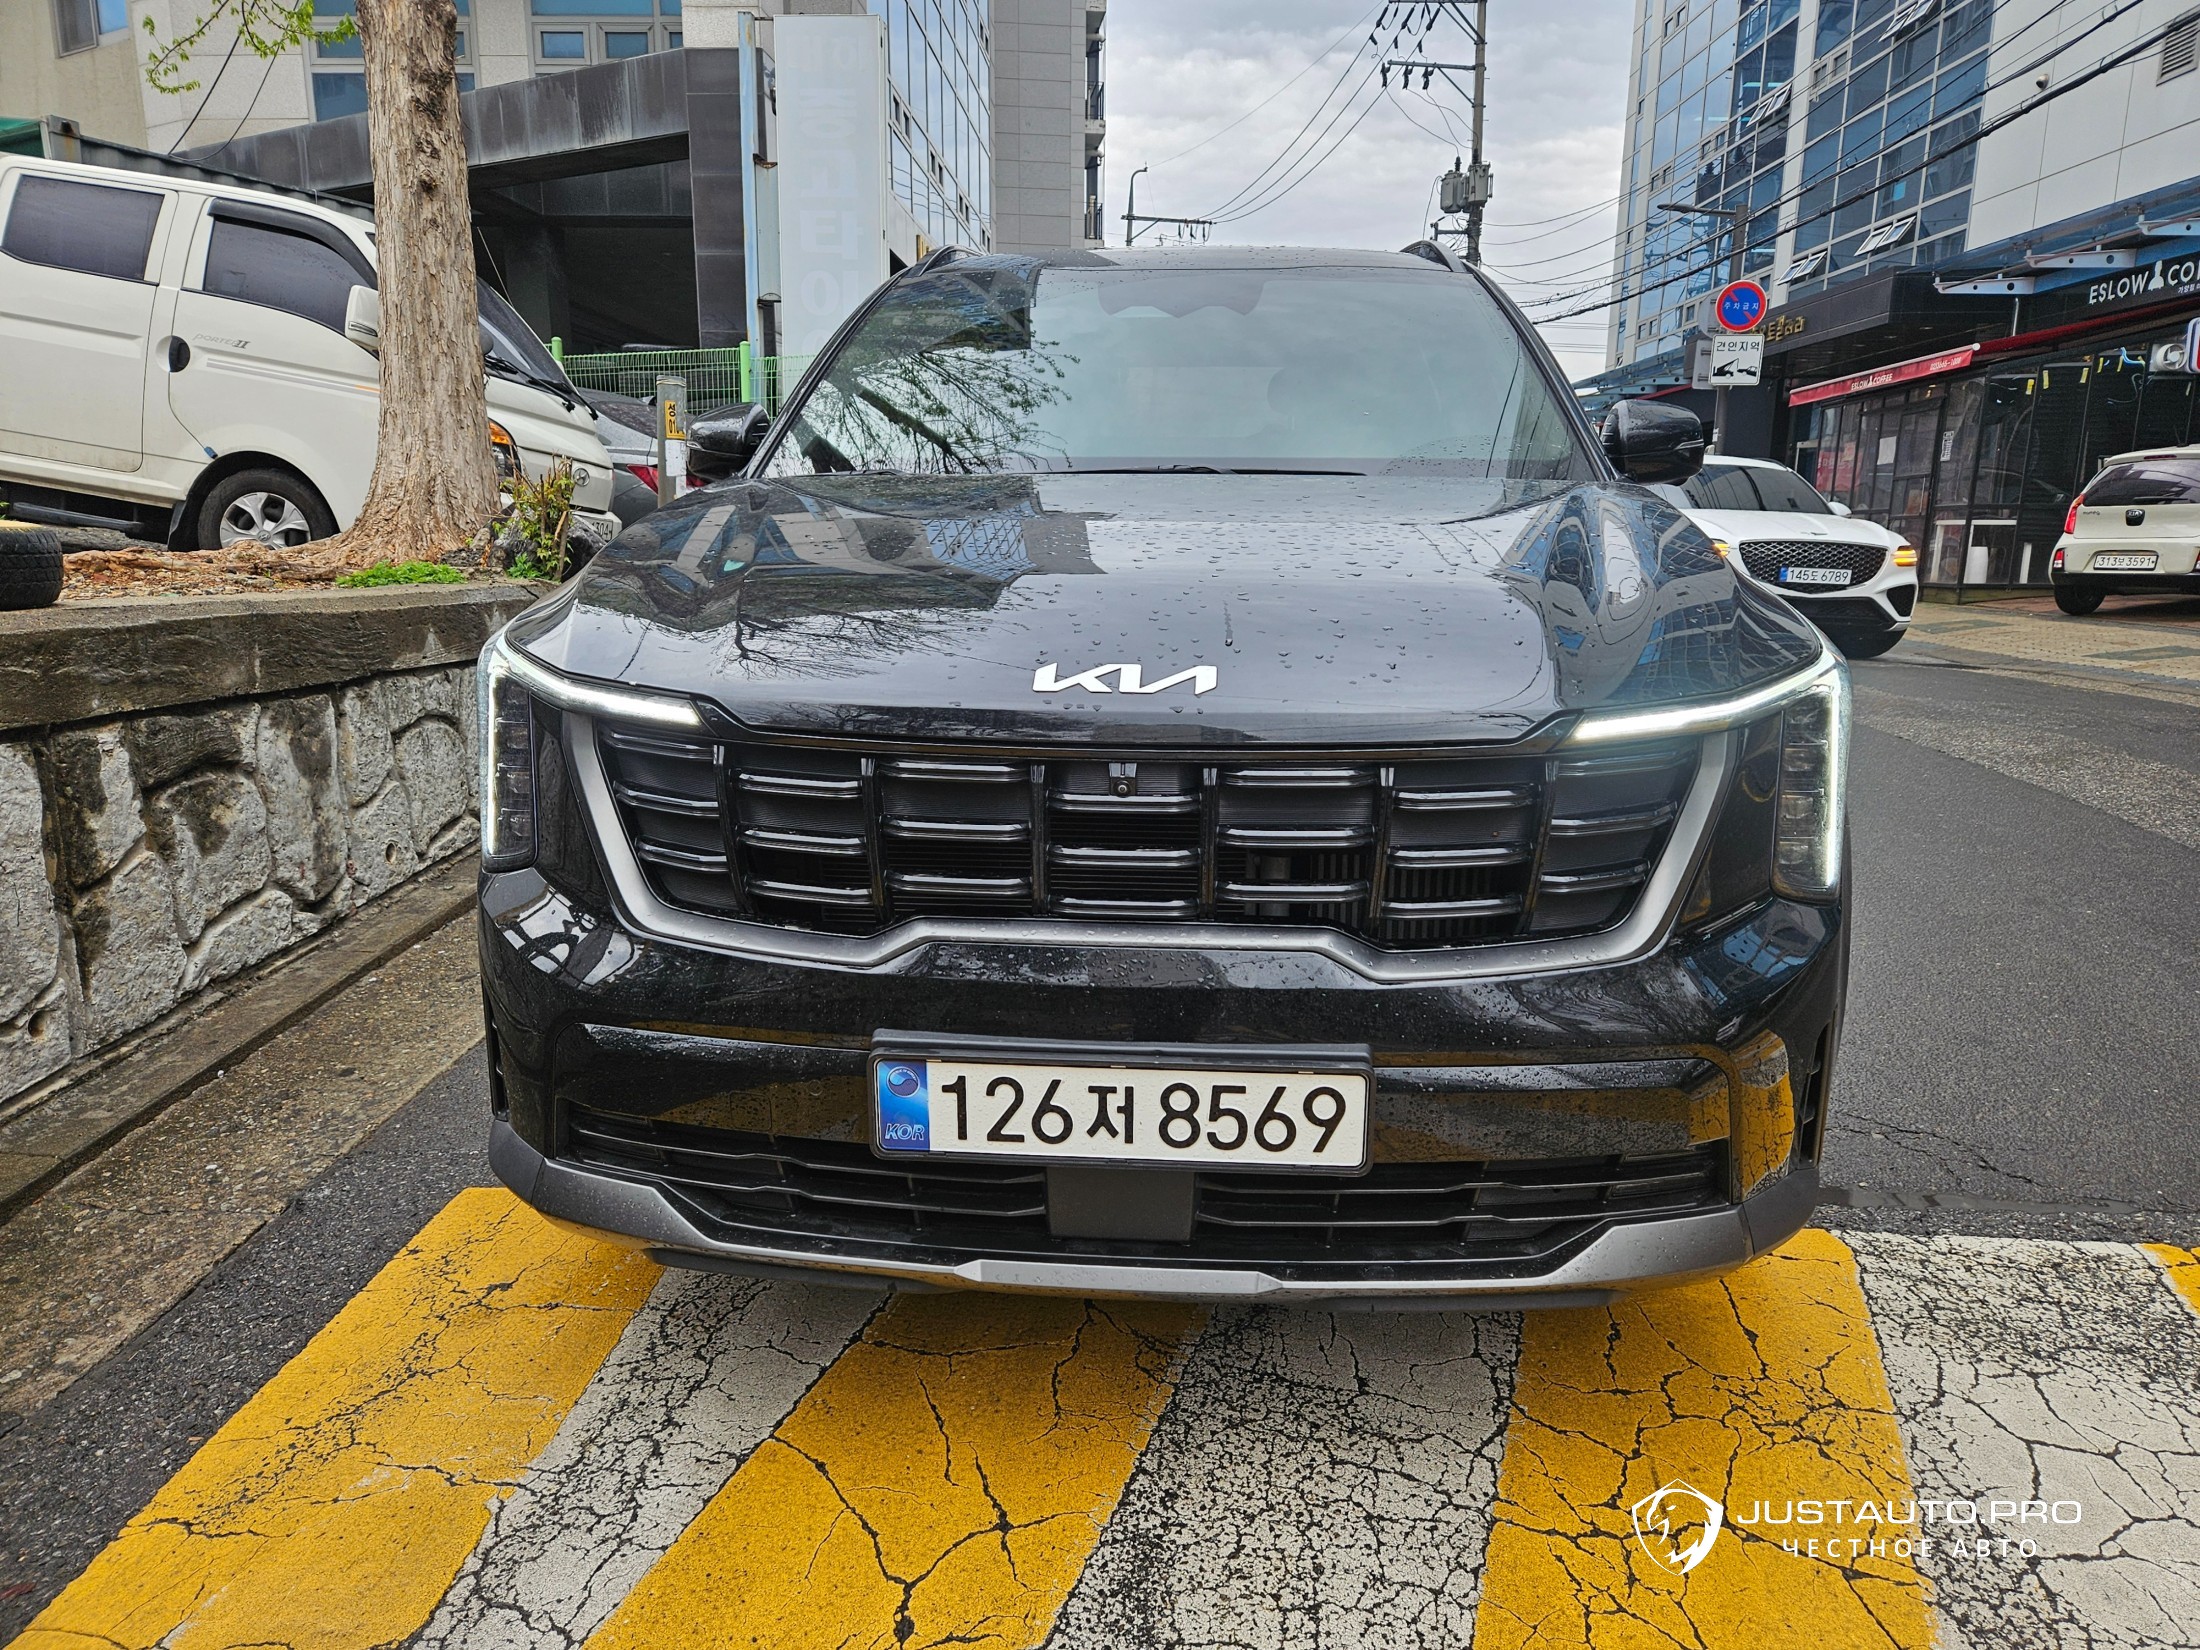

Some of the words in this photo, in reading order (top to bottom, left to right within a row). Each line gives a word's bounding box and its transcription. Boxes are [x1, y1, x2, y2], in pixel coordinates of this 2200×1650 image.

[2088, 271, 2149, 305] ESLOW
[1716, 341, 1760, 352] 견인지역
[1873, 373, 1893, 386] COFFEE
[1820, 570, 1849, 582] 6789
[1032, 662, 1218, 695] KIA
[941, 1074, 1134, 1145] 126저
[1158, 1082, 1347, 1153] 8569
[884, 1123, 925, 1140] KOR
